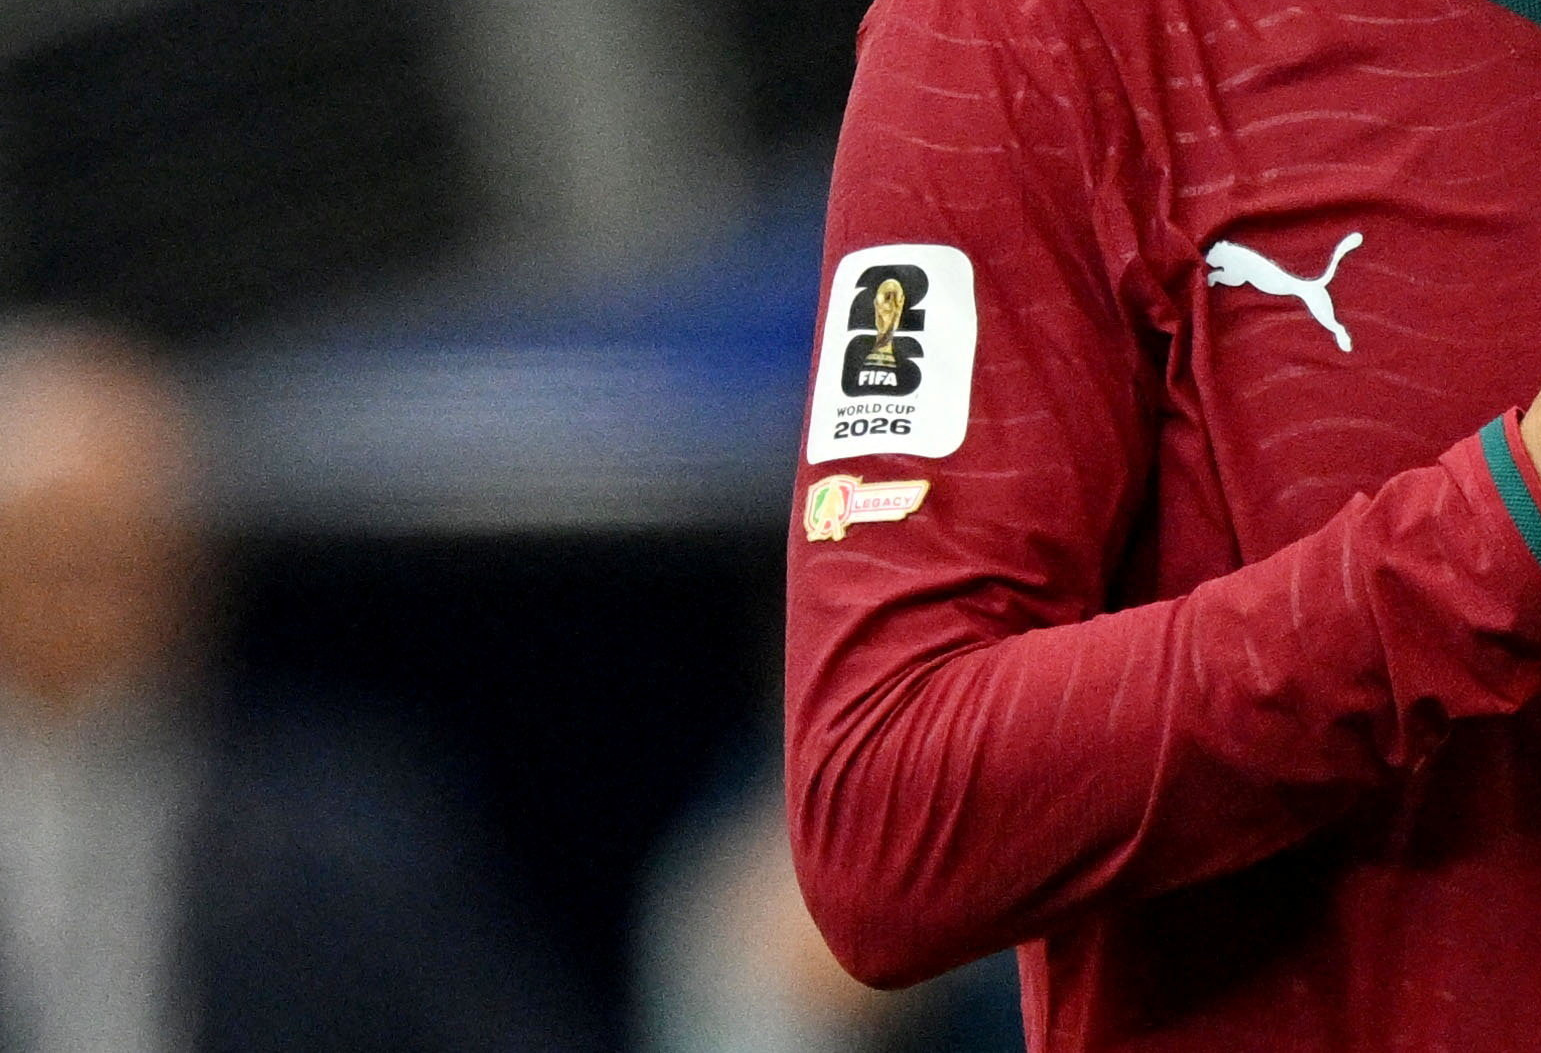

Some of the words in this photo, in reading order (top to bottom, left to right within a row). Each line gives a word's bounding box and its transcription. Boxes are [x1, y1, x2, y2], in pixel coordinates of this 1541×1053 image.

[858, 370, 897, 386] FIFA
[837, 403, 881, 417] WORLD
[885, 403, 915, 415] CUP
[833, 417, 912, 439] 2026
[854, 497, 912, 509] LEGACY
